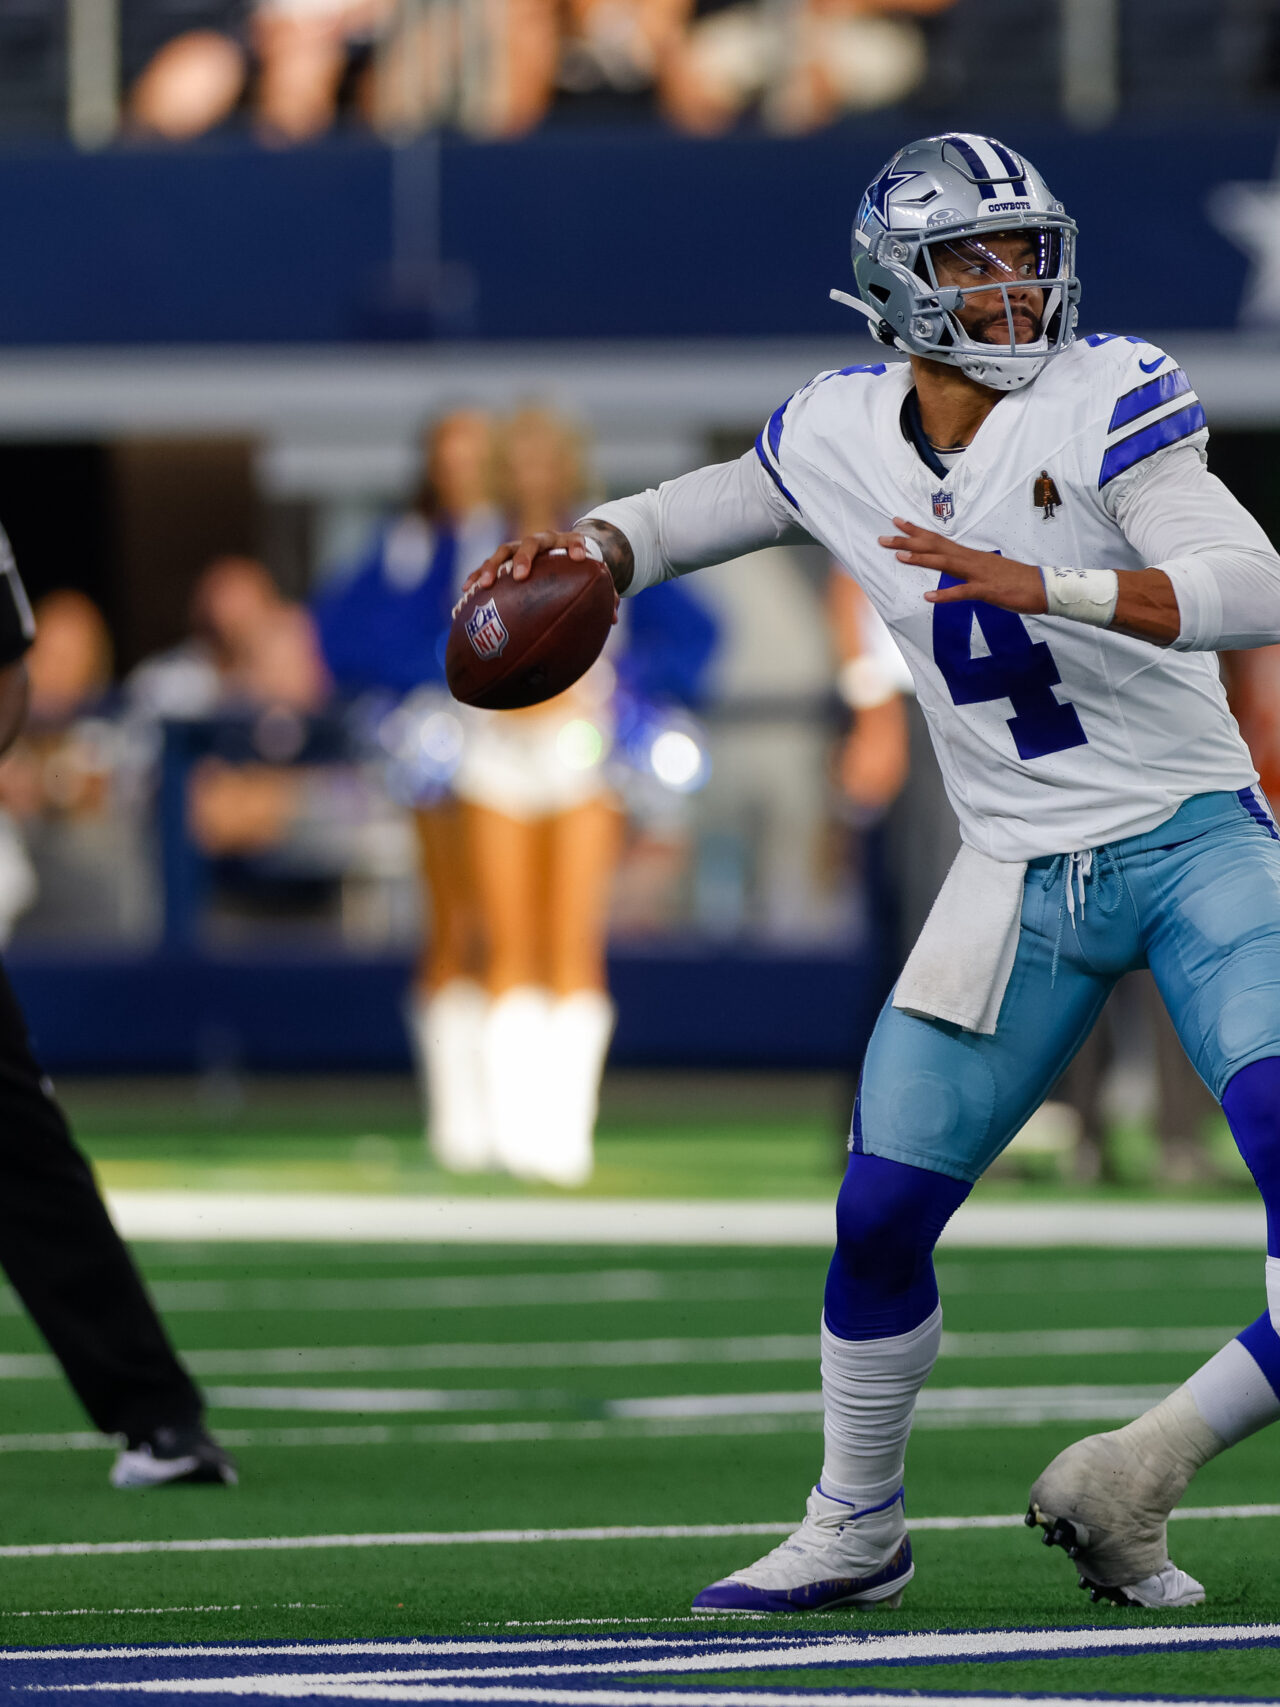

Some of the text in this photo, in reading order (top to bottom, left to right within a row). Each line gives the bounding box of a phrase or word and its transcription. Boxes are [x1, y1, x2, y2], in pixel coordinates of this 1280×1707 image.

[988, 201, 1031, 213] COWBOYS
[935, 503, 951, 517] NFL
[474, 622, 504, 654] NFL
[932, 549, 1089, 761] 4
